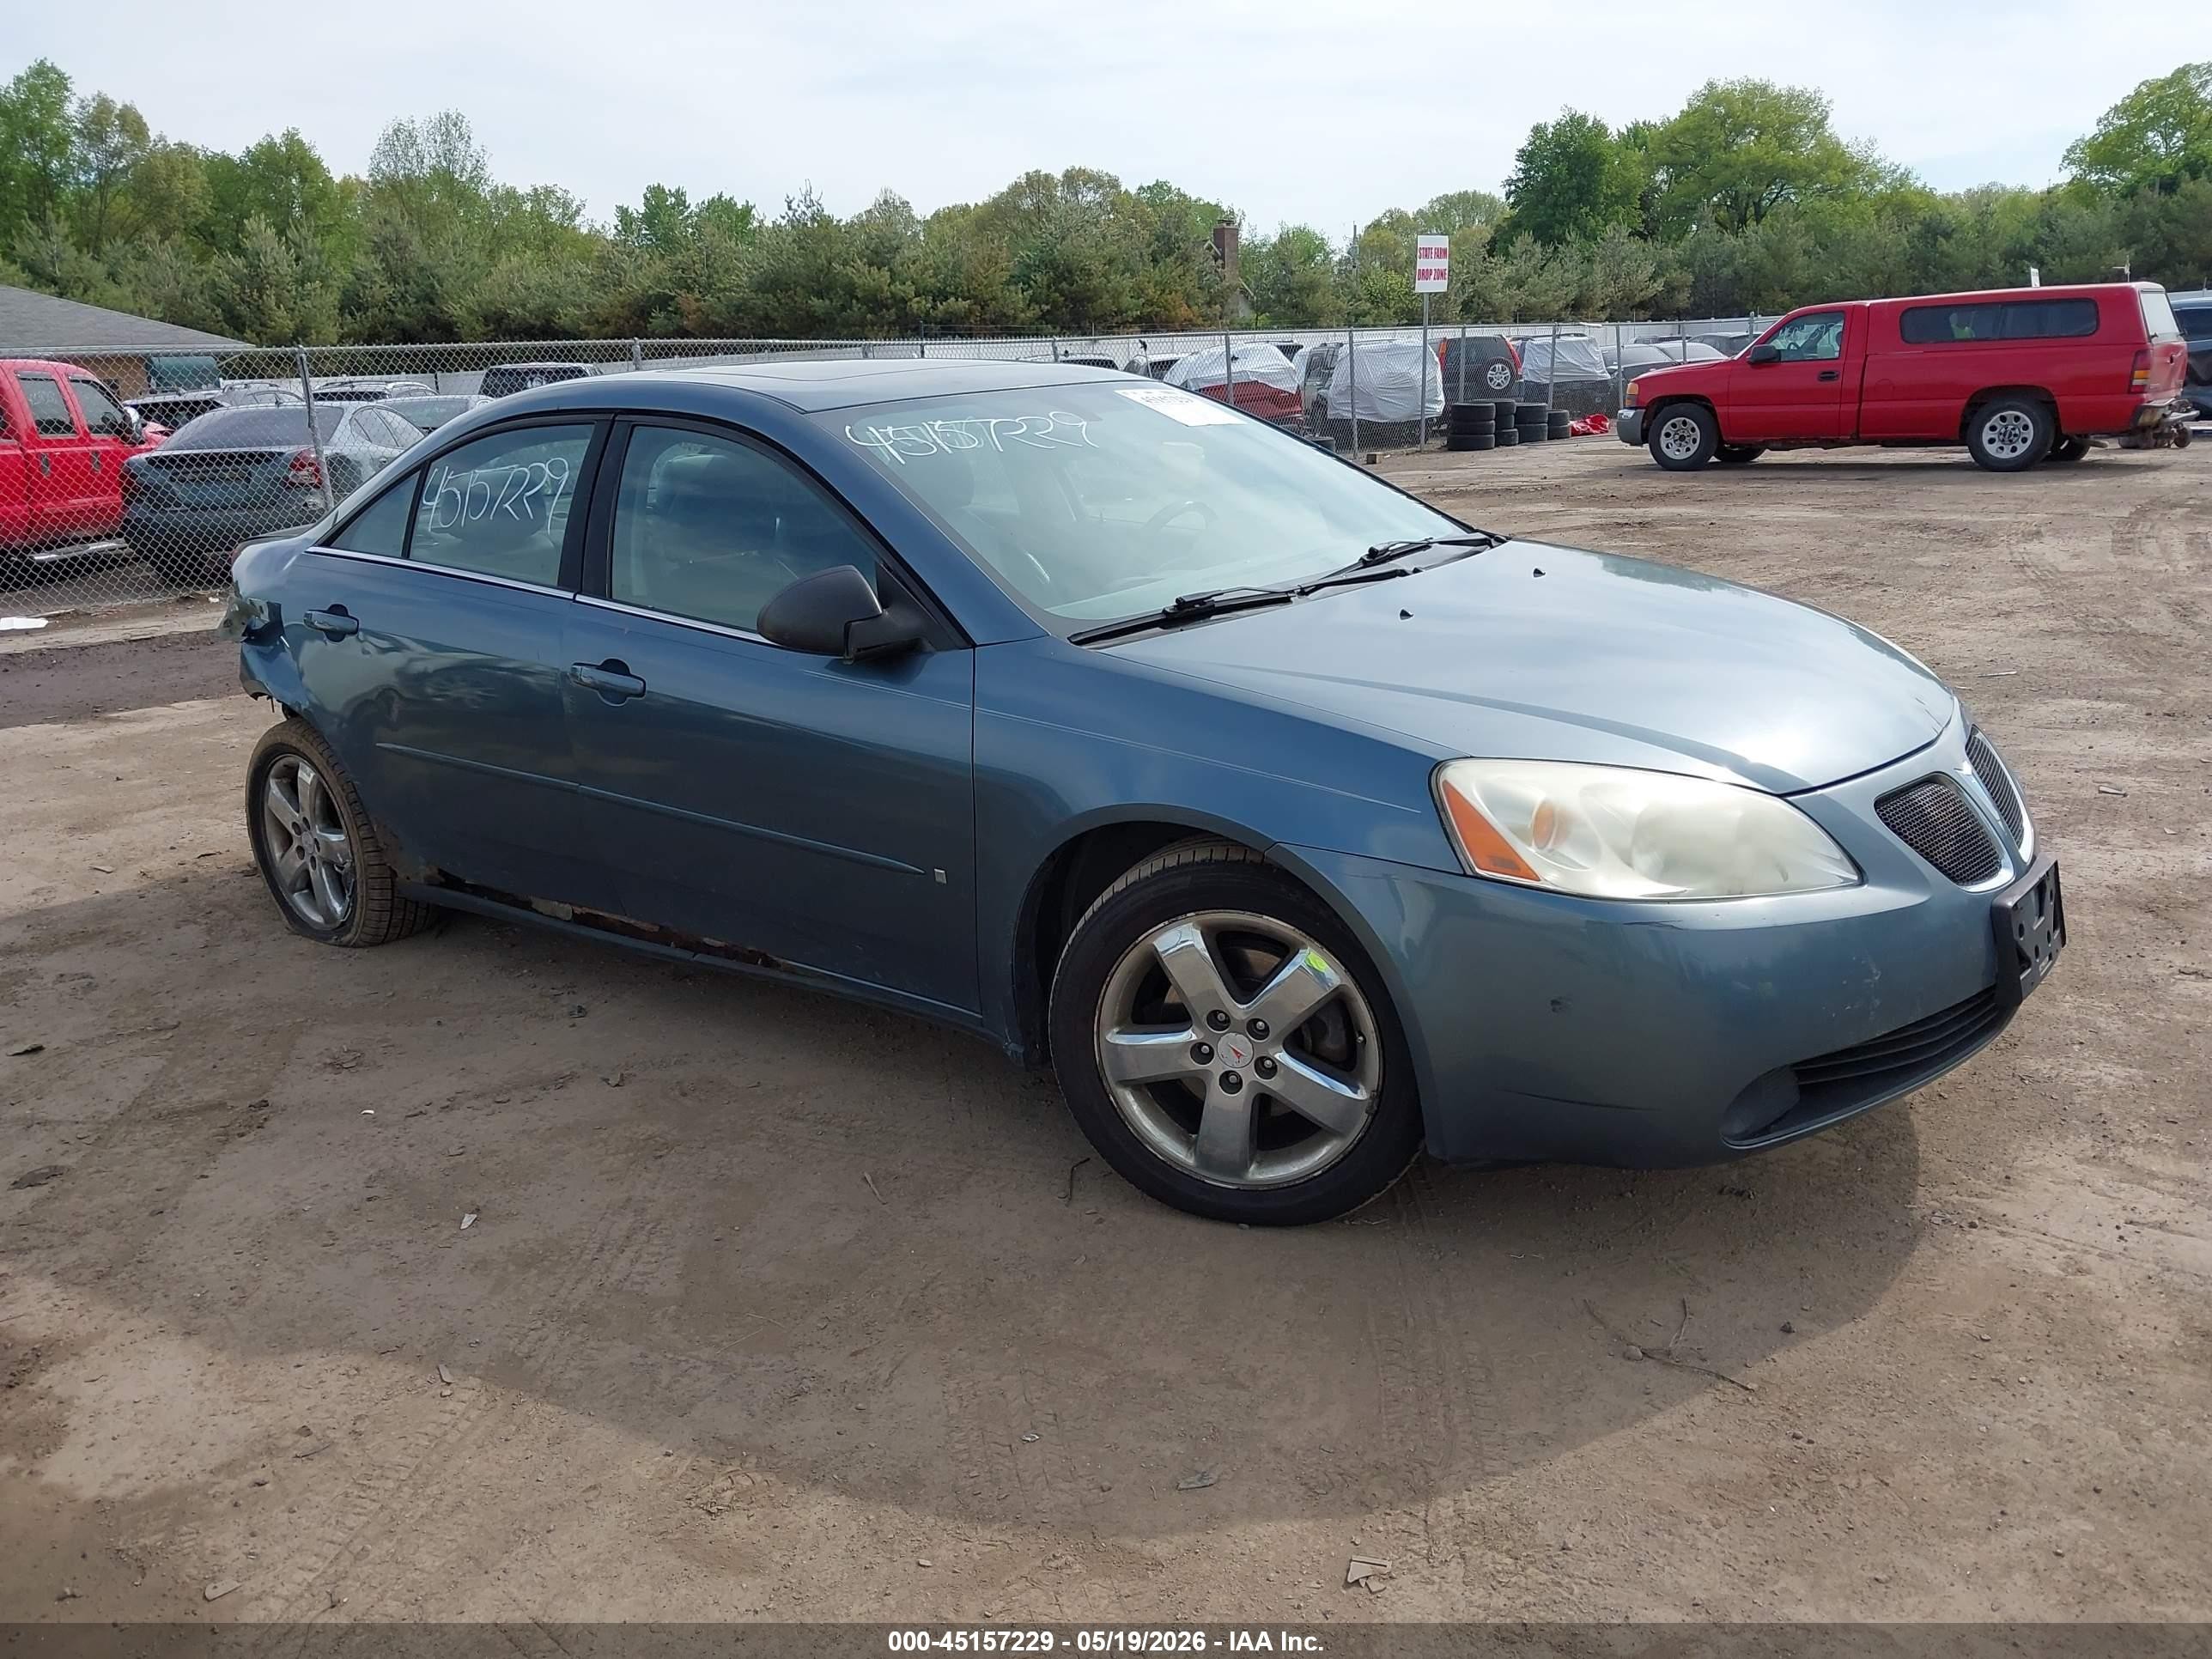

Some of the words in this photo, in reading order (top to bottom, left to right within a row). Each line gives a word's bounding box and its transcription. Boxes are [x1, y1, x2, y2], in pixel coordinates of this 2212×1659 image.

[1419, 247, 1433, 259] STATE
[1434, 247, 1448, 259] FARM
[1418, 269, 1433, 281] DROP
[1433, 269, 1447, 281] ZONE
[845, 410, 1099, 465] 45157229
[422, 457, 569, 536] 45157229
